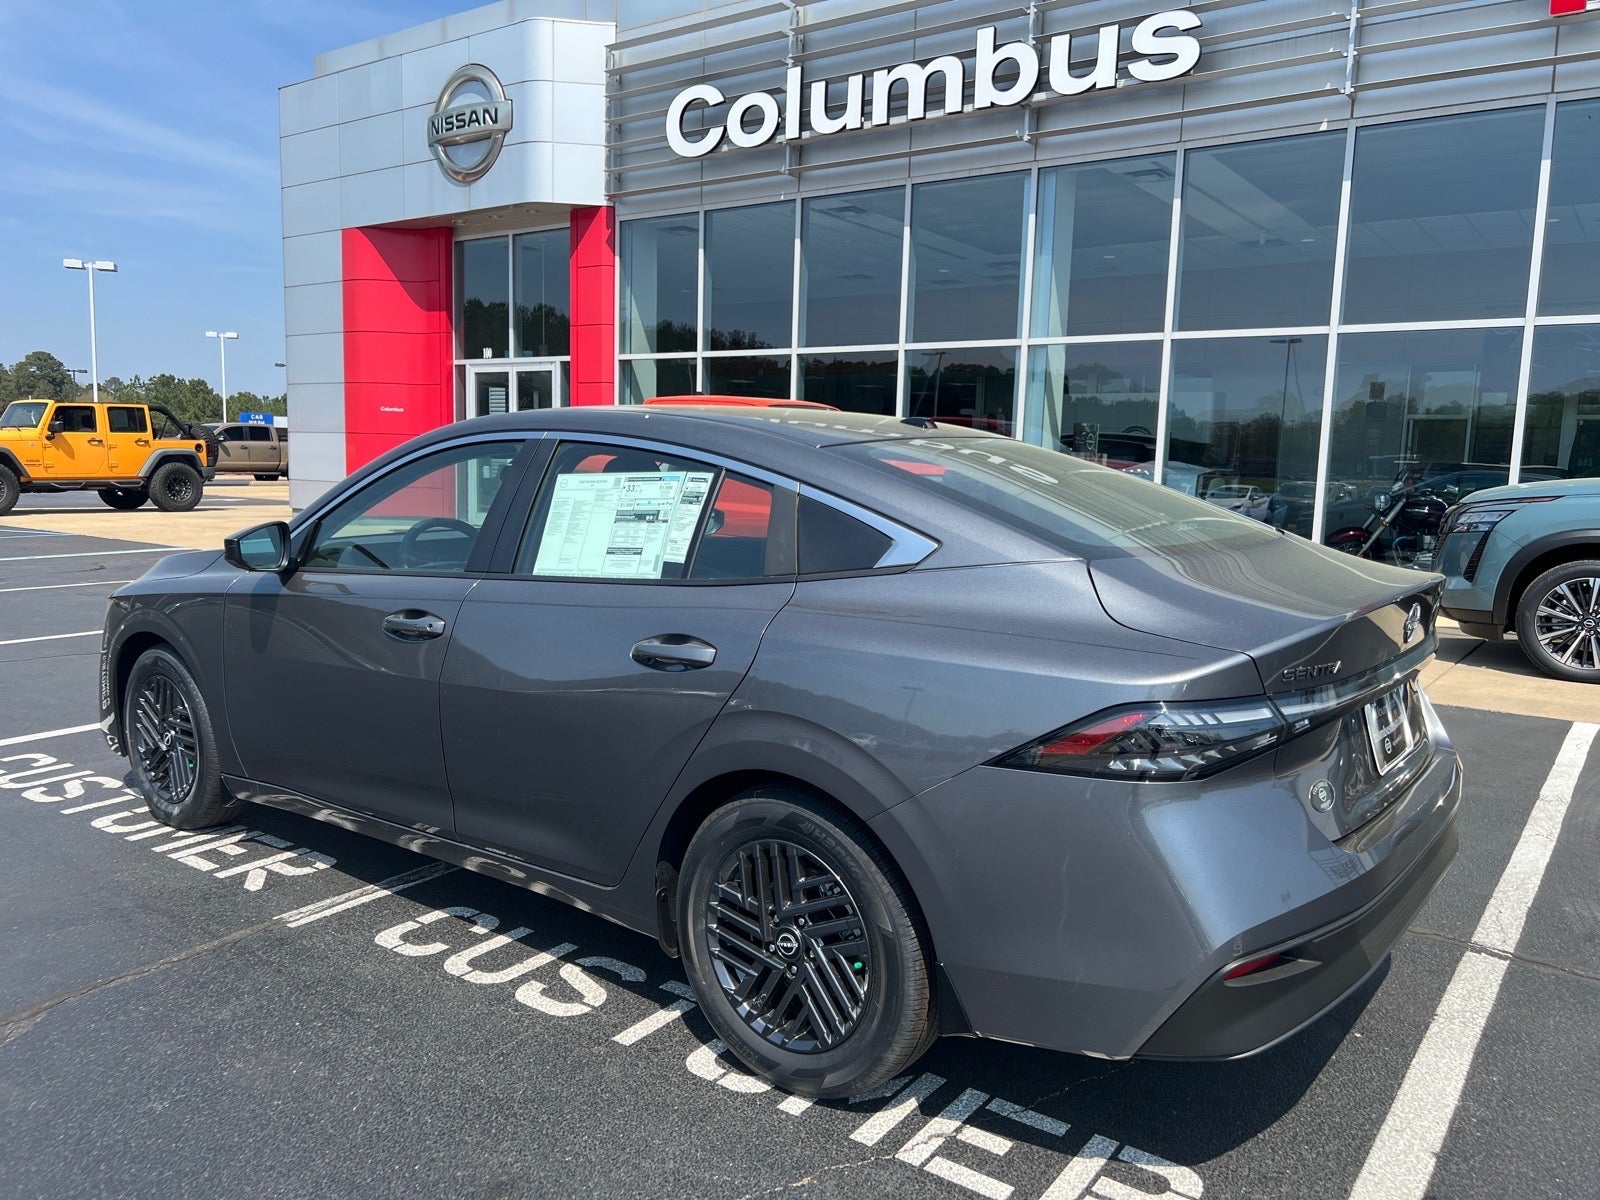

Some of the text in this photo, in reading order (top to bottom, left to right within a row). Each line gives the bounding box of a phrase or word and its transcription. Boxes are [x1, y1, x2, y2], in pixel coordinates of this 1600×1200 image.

[666, 10, 1203, 158] Columbus
[431, 107, 499, 137] NISSAN
[1281, 660, 1343, 683] SENTRA
